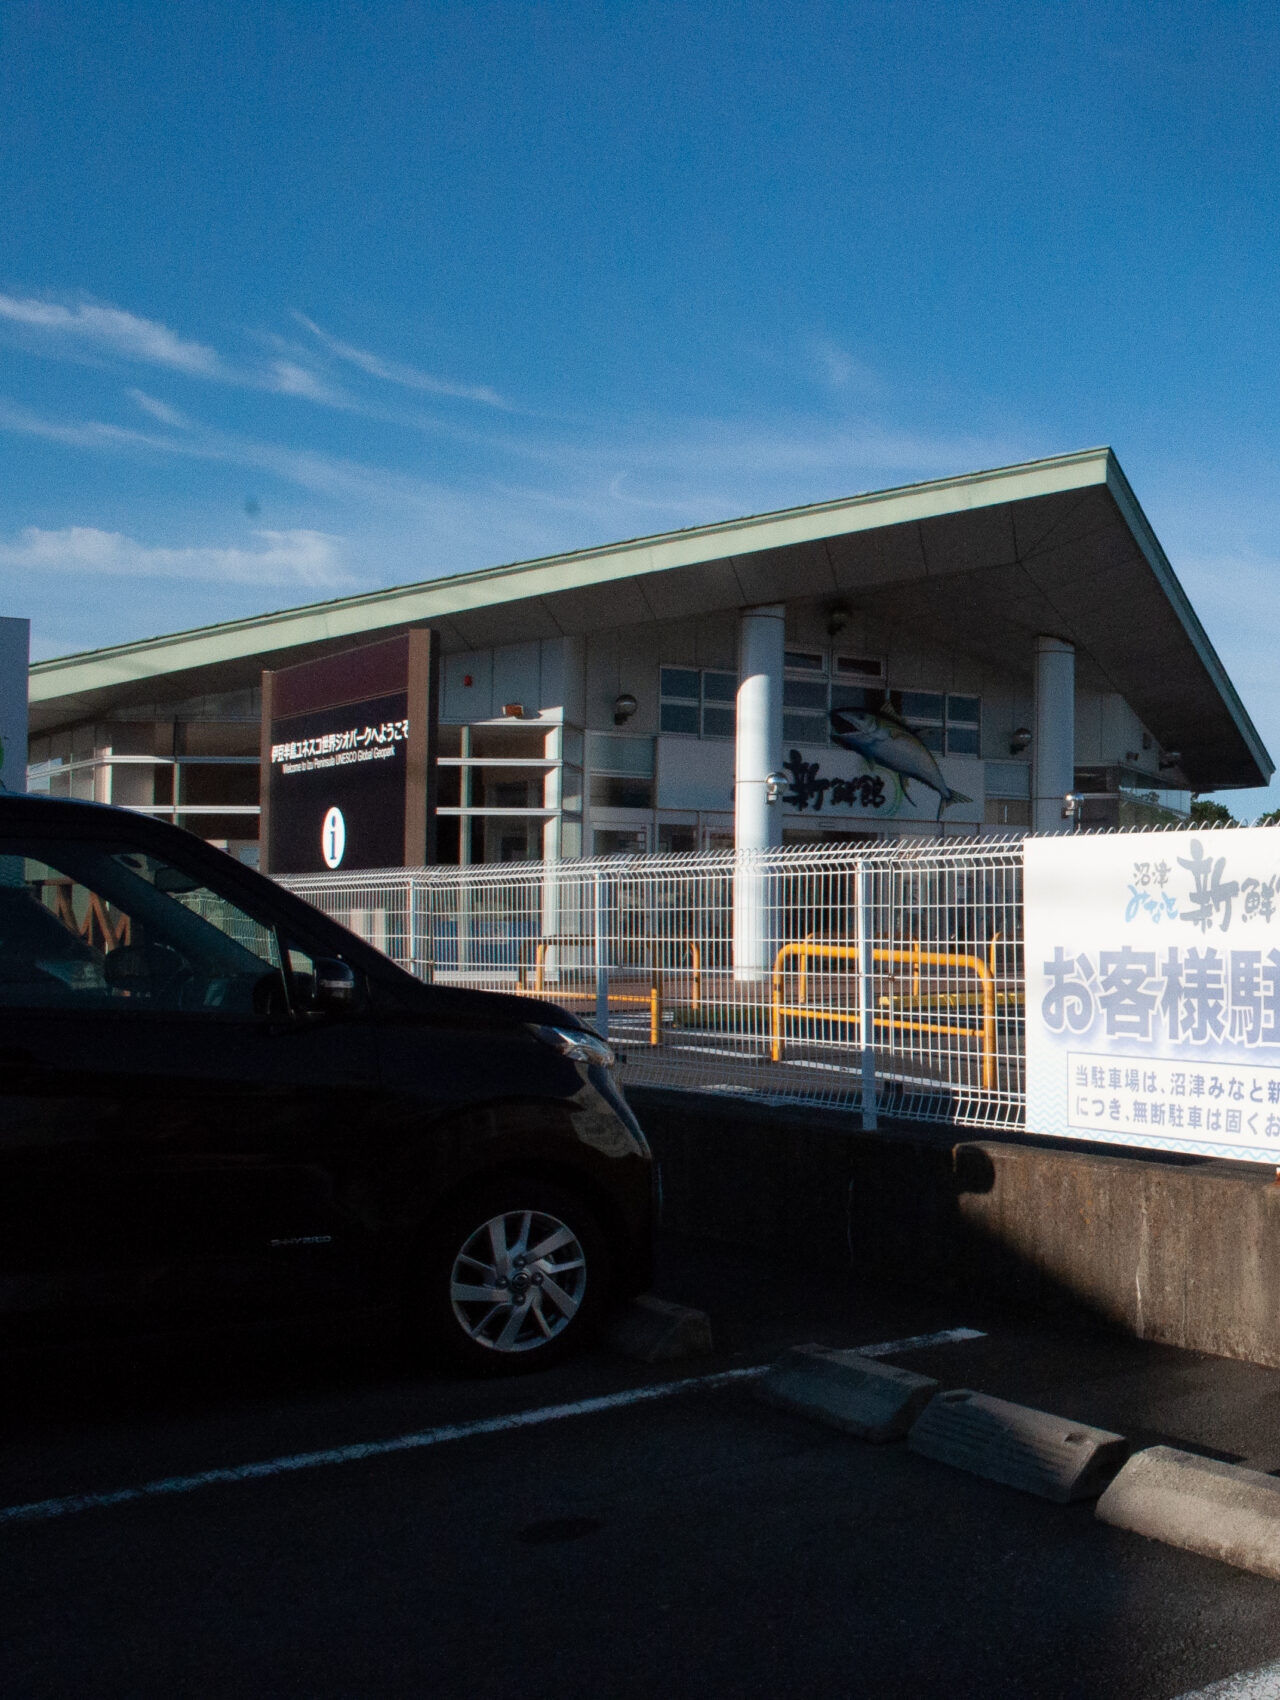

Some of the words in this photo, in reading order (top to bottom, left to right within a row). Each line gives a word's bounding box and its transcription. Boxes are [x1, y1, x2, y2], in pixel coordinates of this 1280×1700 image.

[271, 719, 409, 763] 伊豆半島ユネスコ世界ジオパークへようこそ
[336, 751, 357, 766] UNESCO
[358, 748, 373, 762] Global
[374, 745, 395, 760] Geopark
[1133, 858, 1172, 888] 沼津
[1125, 884, 1179, 924] みなと
